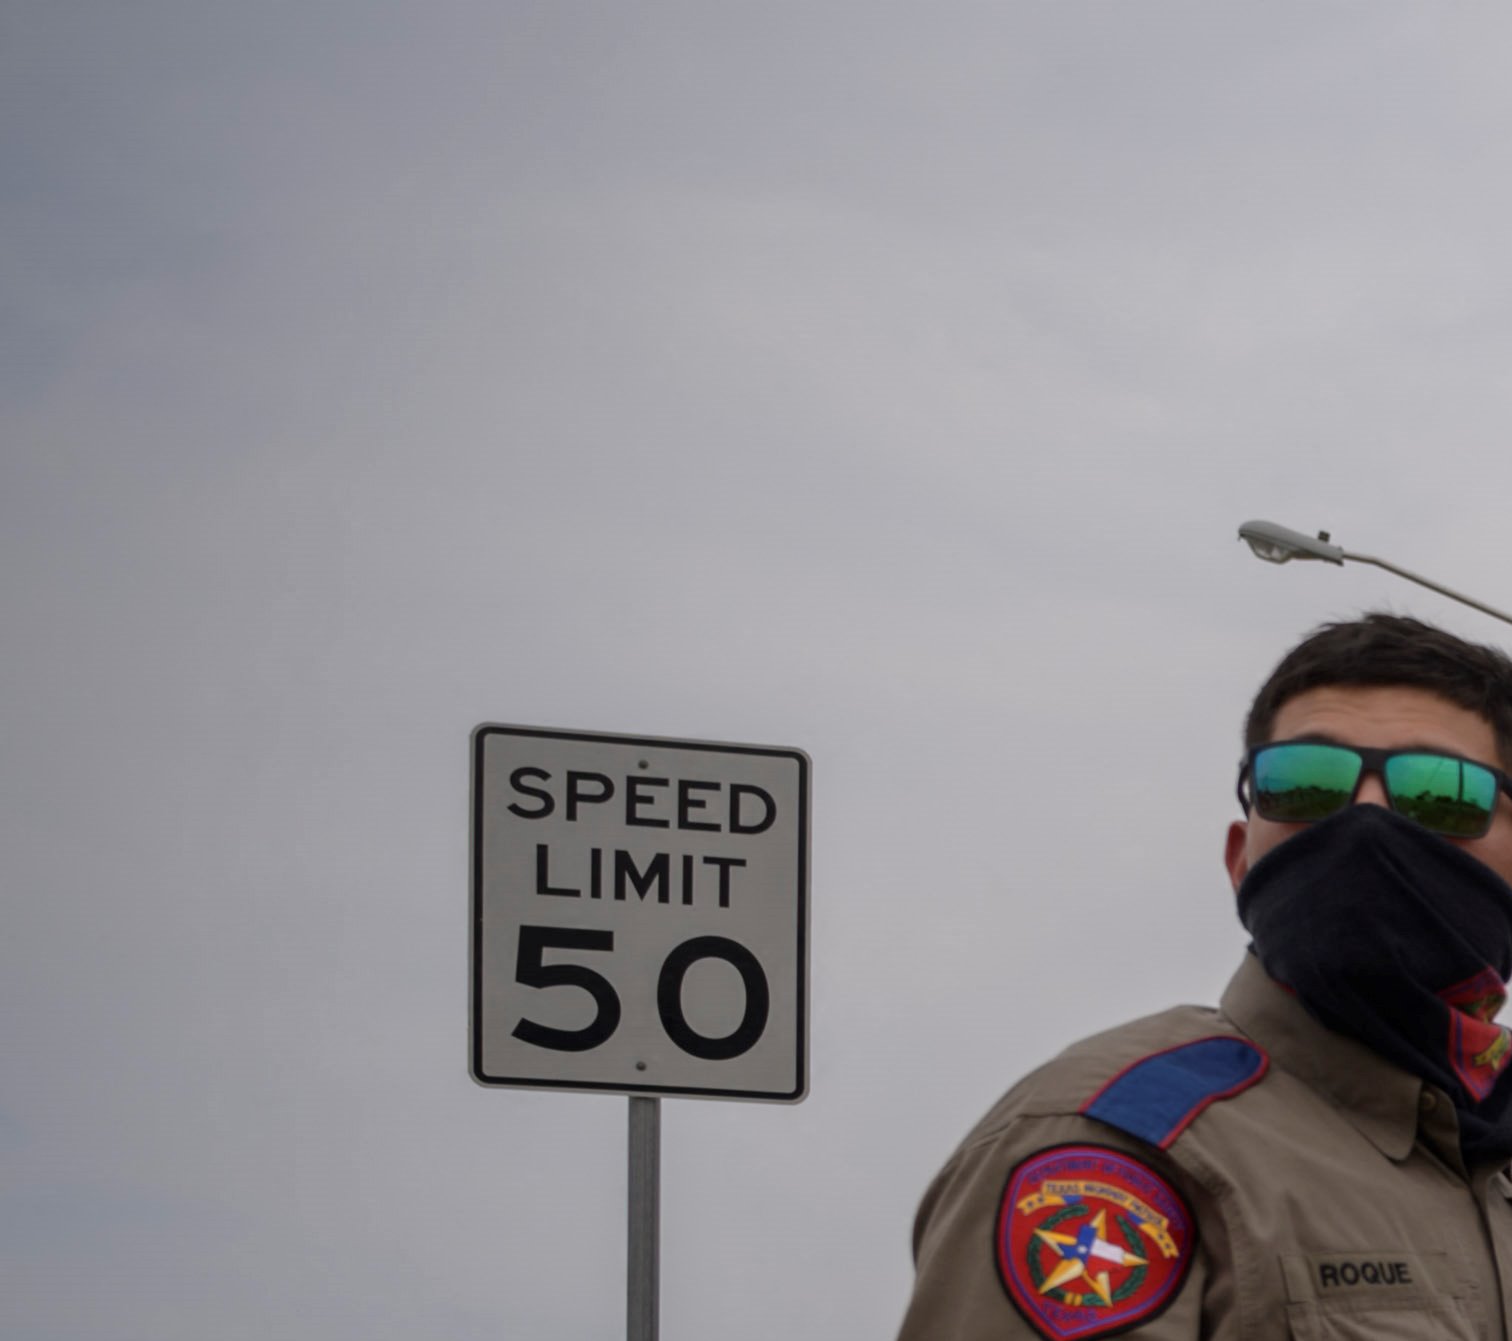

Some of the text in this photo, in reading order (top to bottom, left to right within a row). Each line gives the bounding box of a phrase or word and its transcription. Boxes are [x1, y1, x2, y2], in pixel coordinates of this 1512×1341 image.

[507, 766, 777, 835] SPEED
[536, 843, 747, 908] LIMIT
[511, 924, 770, 1061] 50
[1319, 1261, 1413, 1288] ROQUE
